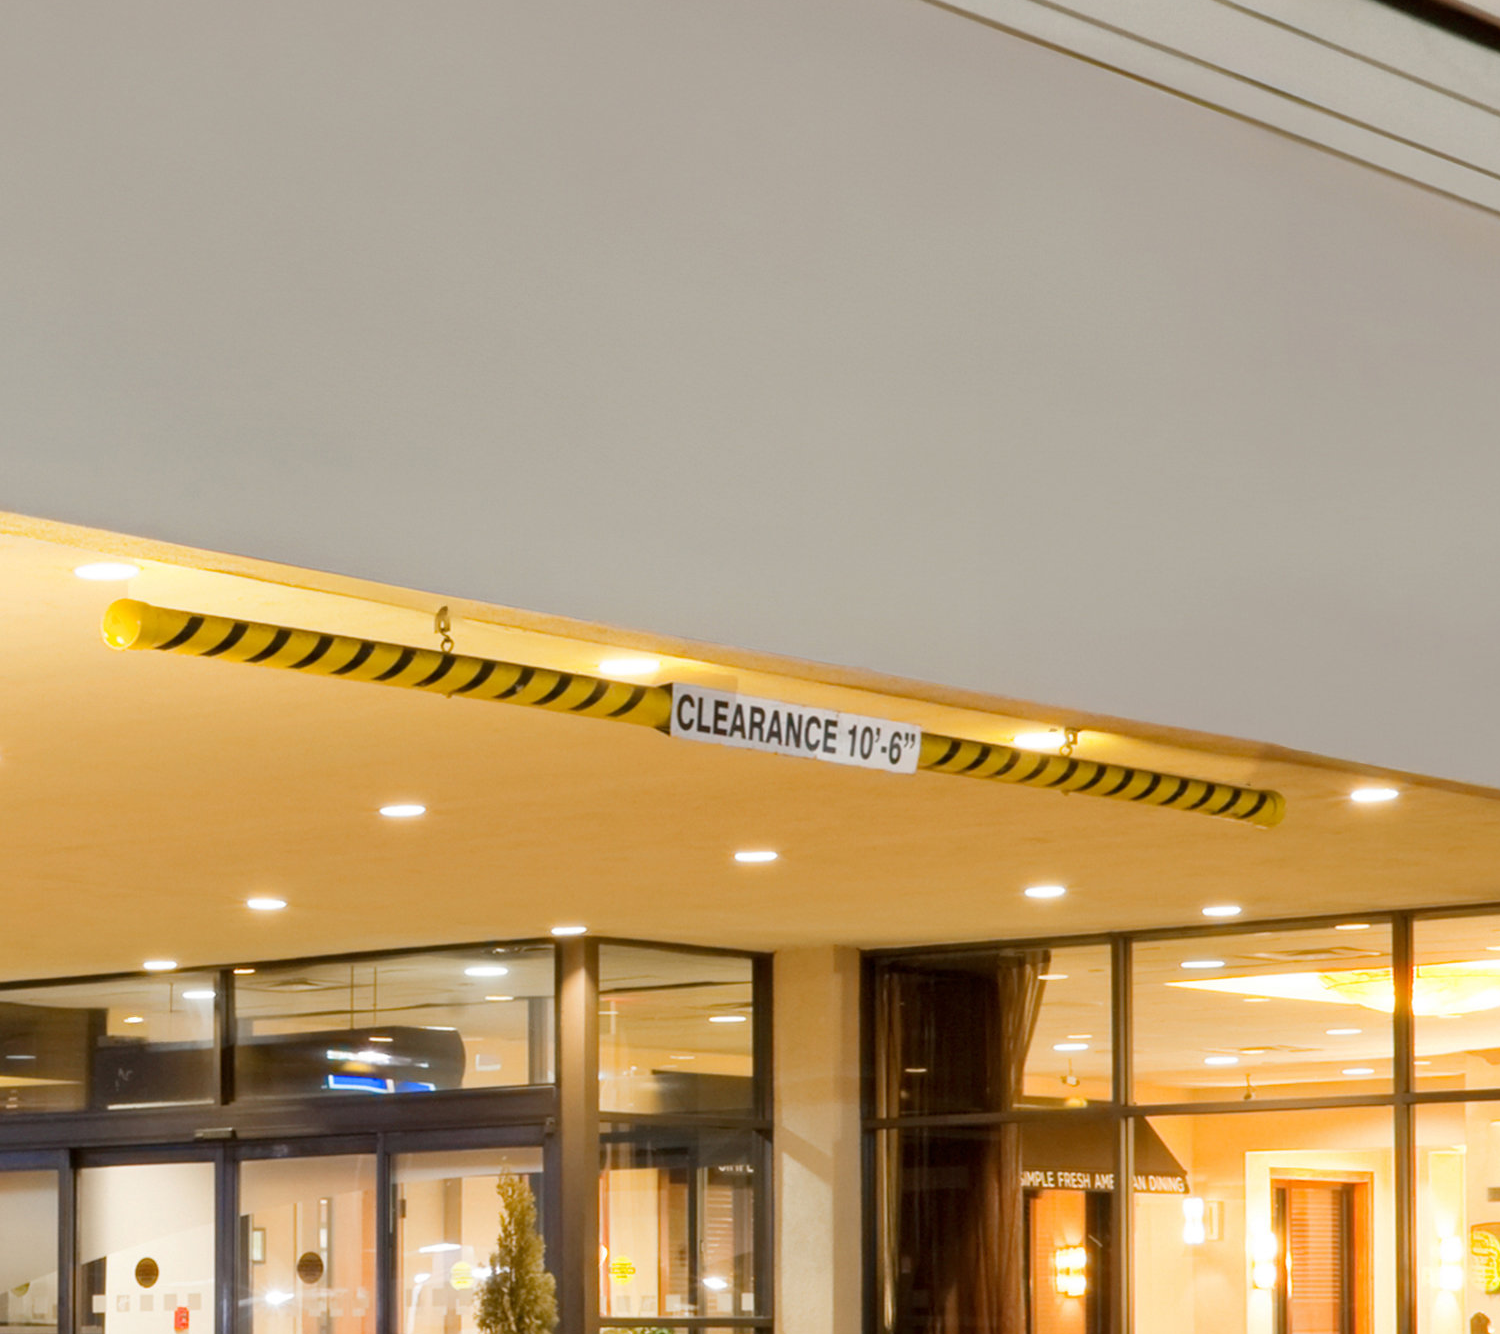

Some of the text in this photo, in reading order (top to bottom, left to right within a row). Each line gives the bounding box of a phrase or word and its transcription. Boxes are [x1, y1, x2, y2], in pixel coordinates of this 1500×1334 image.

[676, 693, 838, 754] CLEARANCE
[1057, 1171, 1091, 1189] FRESH
[1148, 1175, 1185, 1192] DINING
